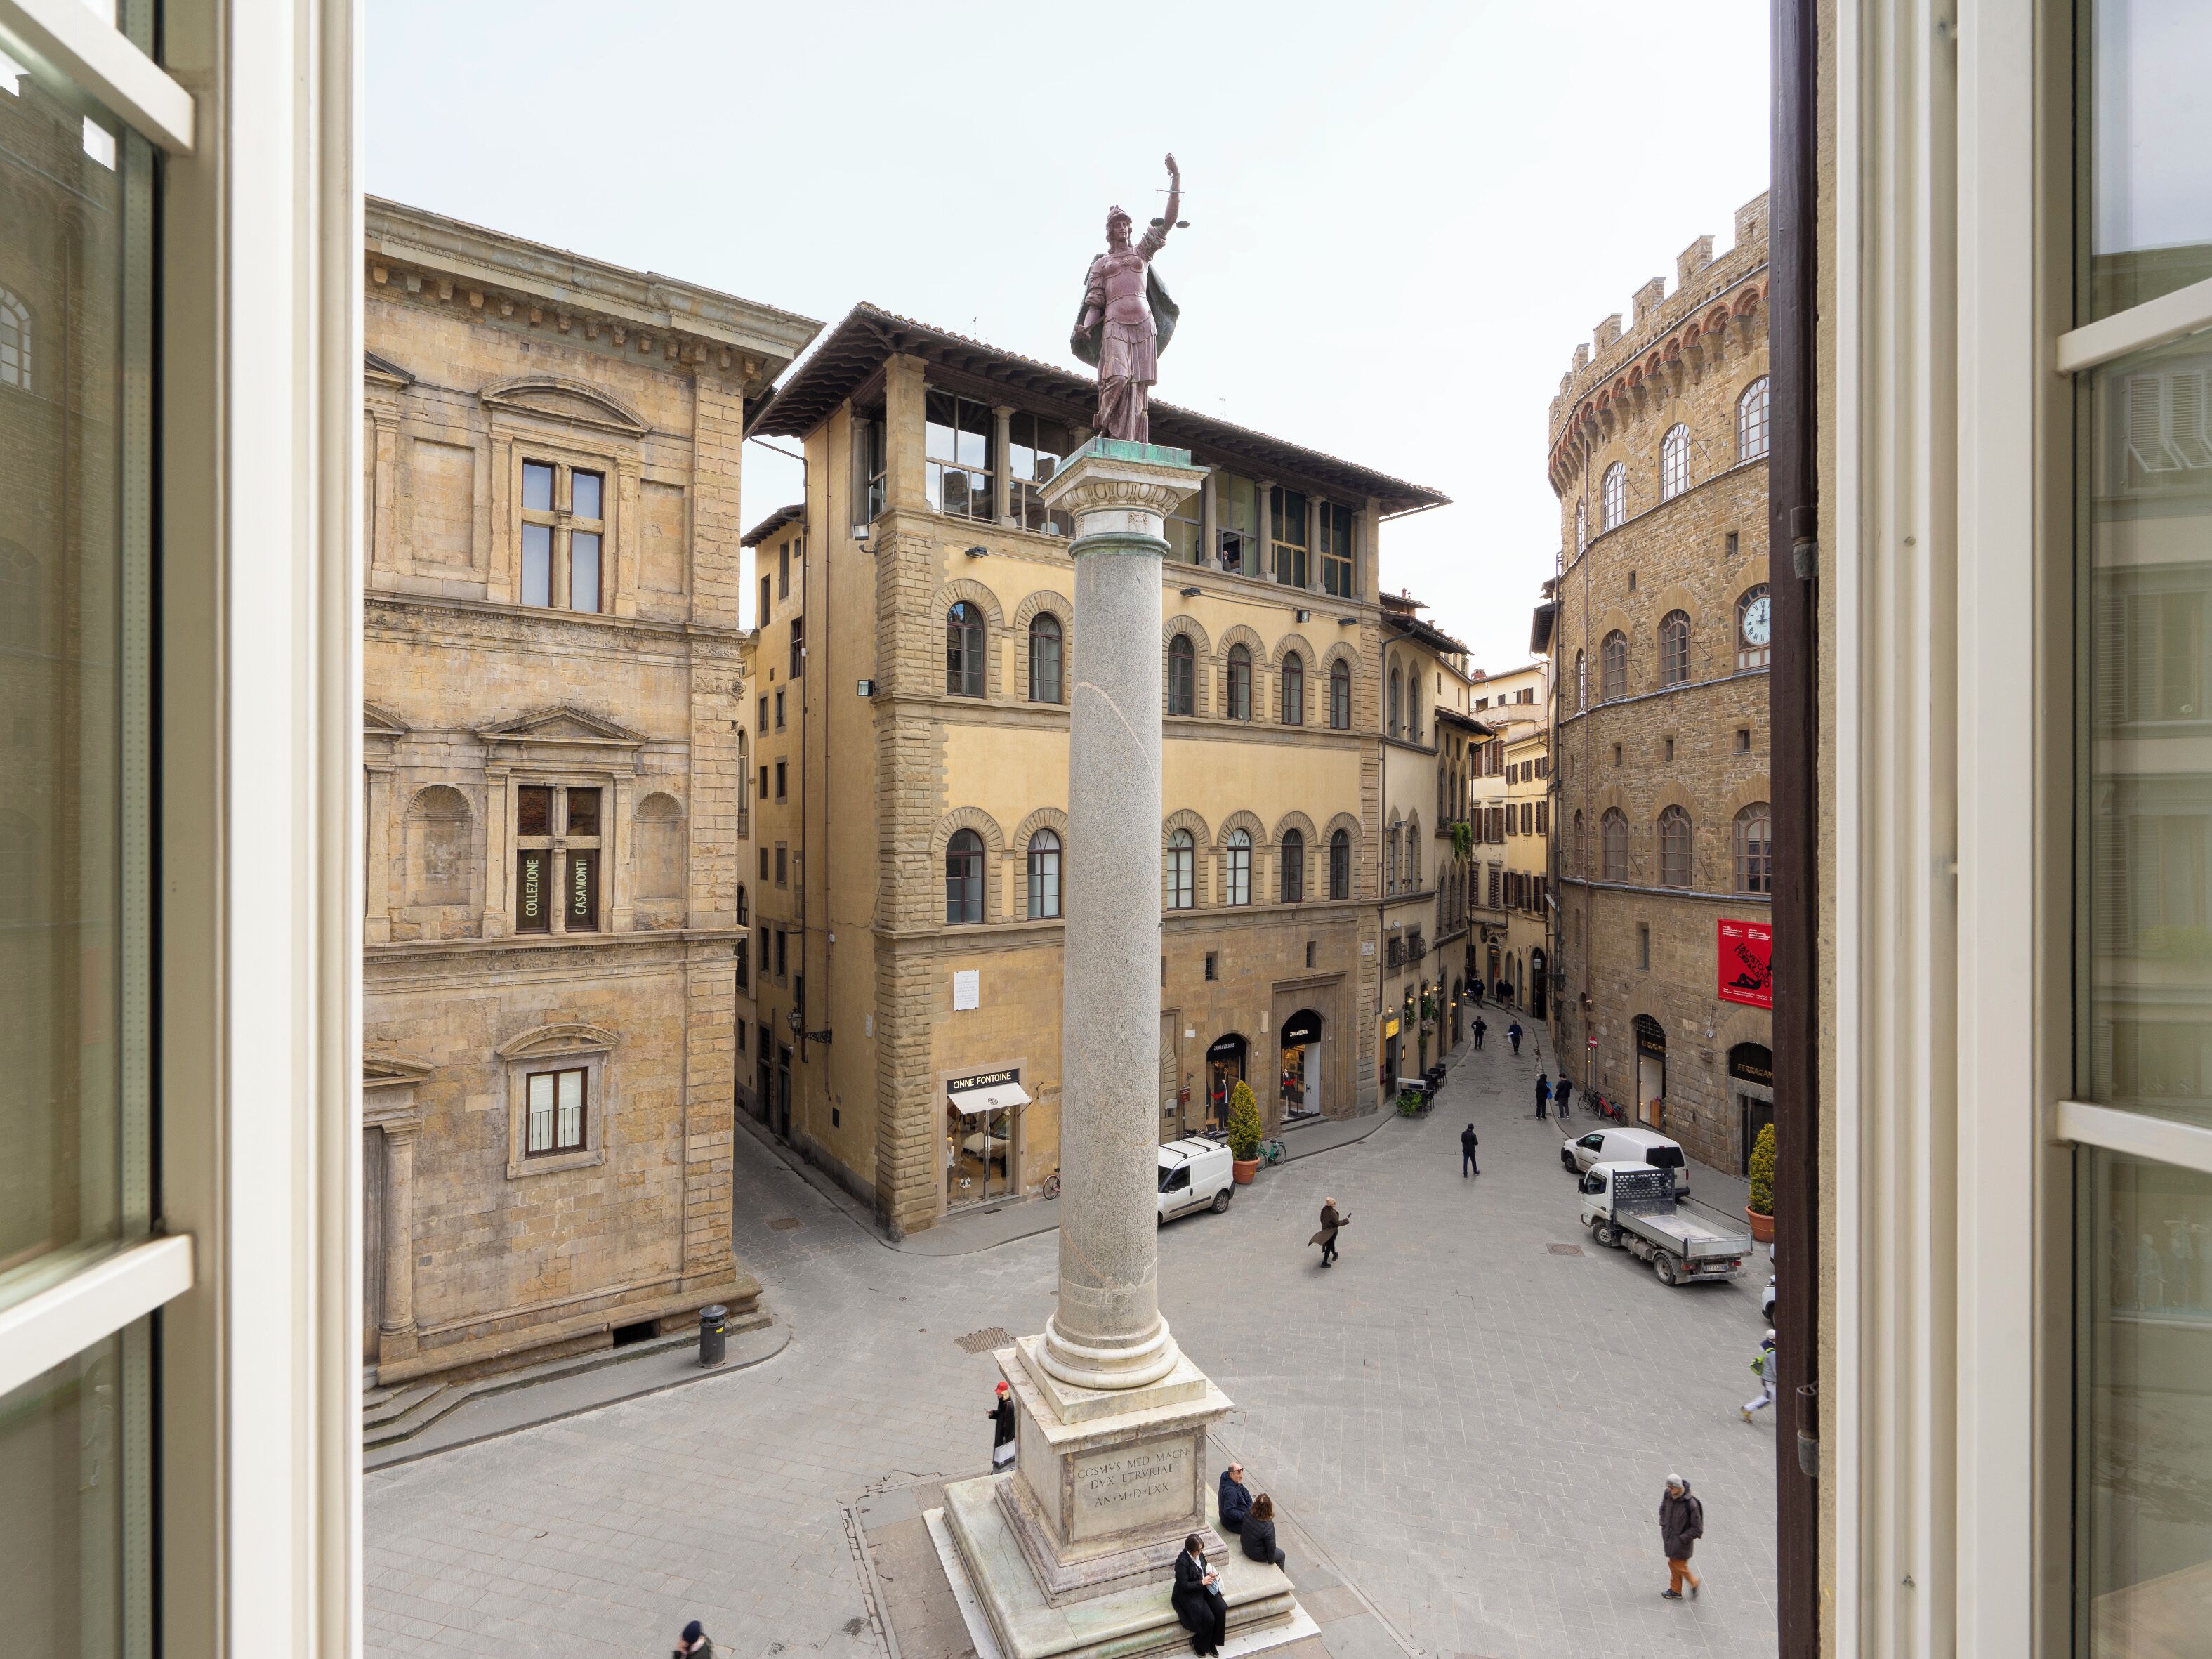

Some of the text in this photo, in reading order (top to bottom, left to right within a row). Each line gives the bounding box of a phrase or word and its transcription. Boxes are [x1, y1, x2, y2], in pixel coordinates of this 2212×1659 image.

[525, 859, 539, 917] COLLEZIONE
[575, 859, 587, 915] CASAMONTI
[1738, 943, 1771, 980] SALVATOE
[953, 1072, 1012, 1089] ANNE FONTAINE
[1077, 1462, 1121, 1479] COSMVS
[1128, 1456, 1150, 1469] MED
[1091, 1463, 1174, 1490] DVX ETRVRIAE
